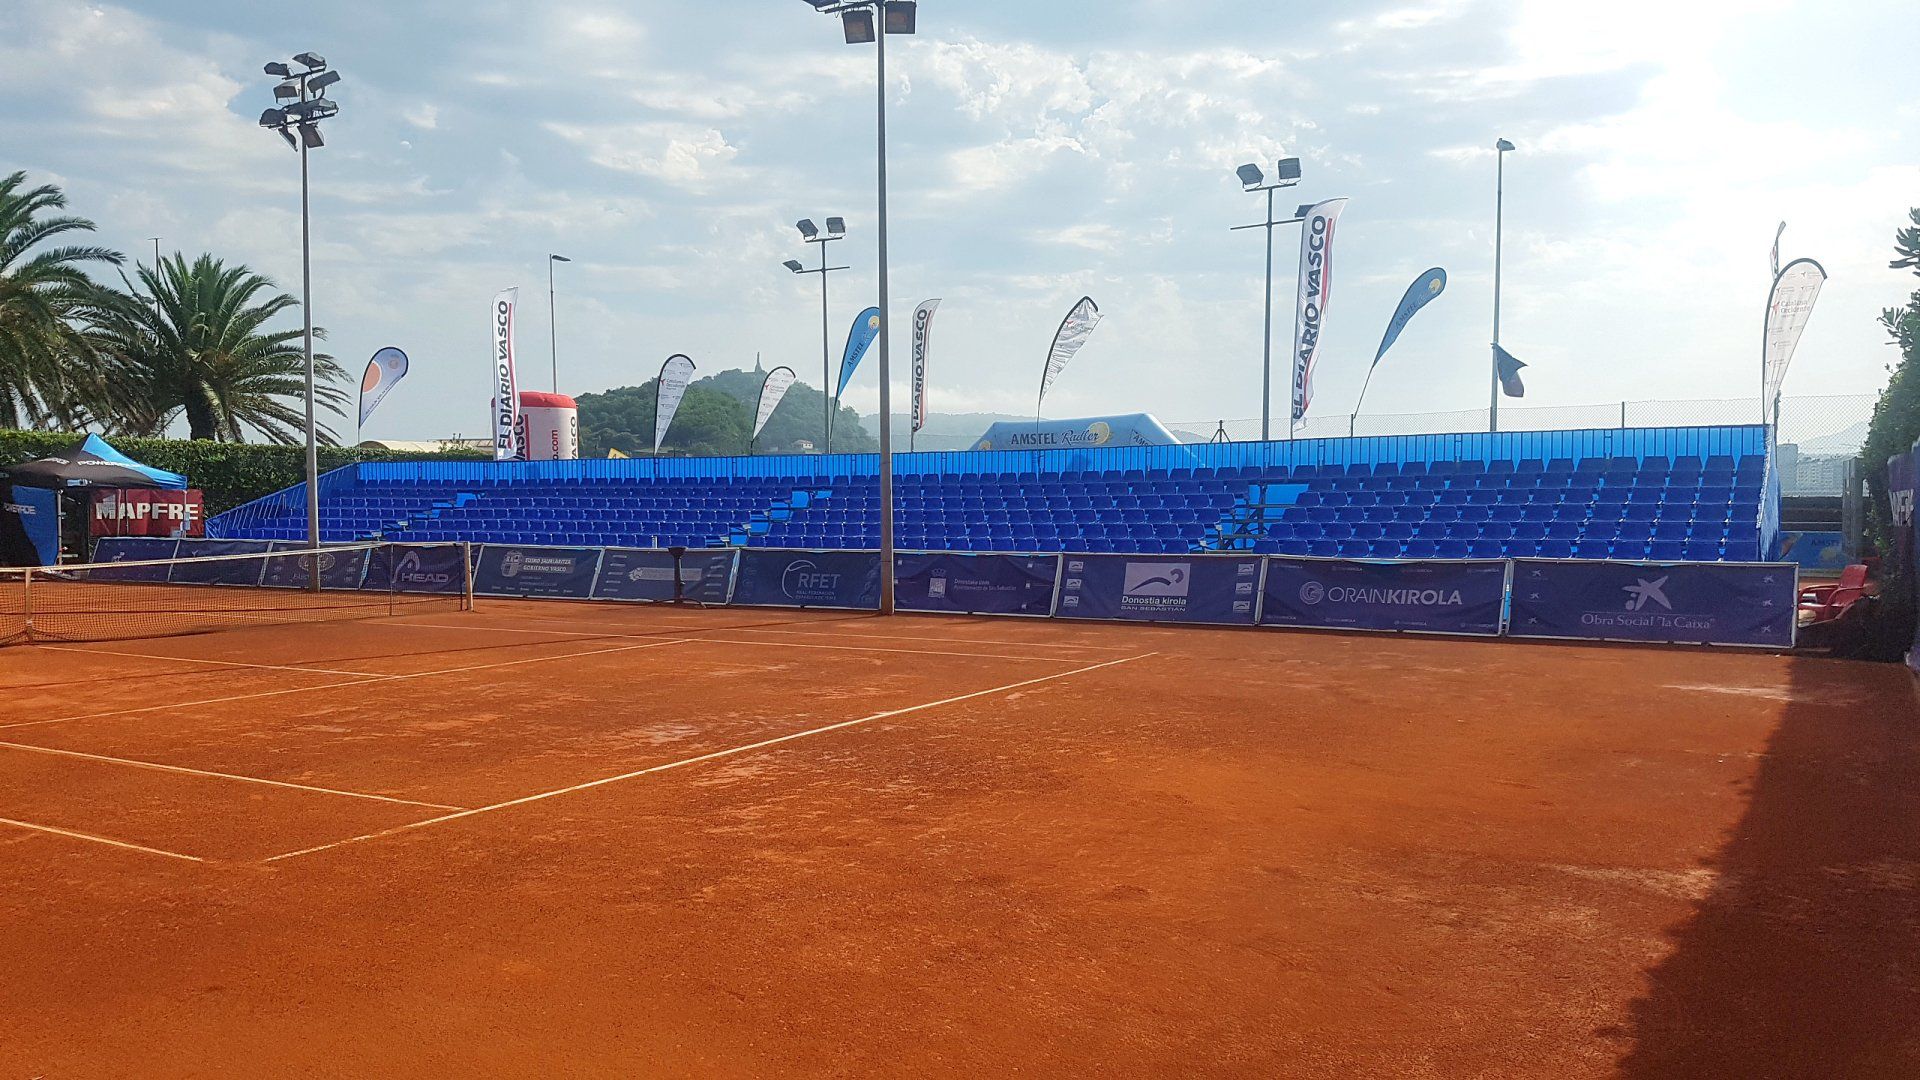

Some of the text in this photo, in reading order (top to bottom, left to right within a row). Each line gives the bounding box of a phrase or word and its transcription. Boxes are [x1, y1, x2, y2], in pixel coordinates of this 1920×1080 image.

[1307, 215, 1326, 299] VASCO
[498, 301, 509, 362] VASCO
[915, 308, 928, 361] VASCO
[1296, 303, 1320, 389] DIARIO
[499, 364, 513, 427] DIARIO
[913, 365, 924, 420] DIARIO
[1011, 429, 1101, 446] AMSTEL Radler
[95, 502, 200, 520] MAPFRE
[401, 573, 449, 583] HEAD
[798, 573, 840, 589] RFET
[1121, 595, 1187, 606] Donostia kirola
[1328, 586, 1463, 605] ORAINKIROLA
[1581, 613, 1613, 625] Obra
[1616, 614, 1654, 627] Social
